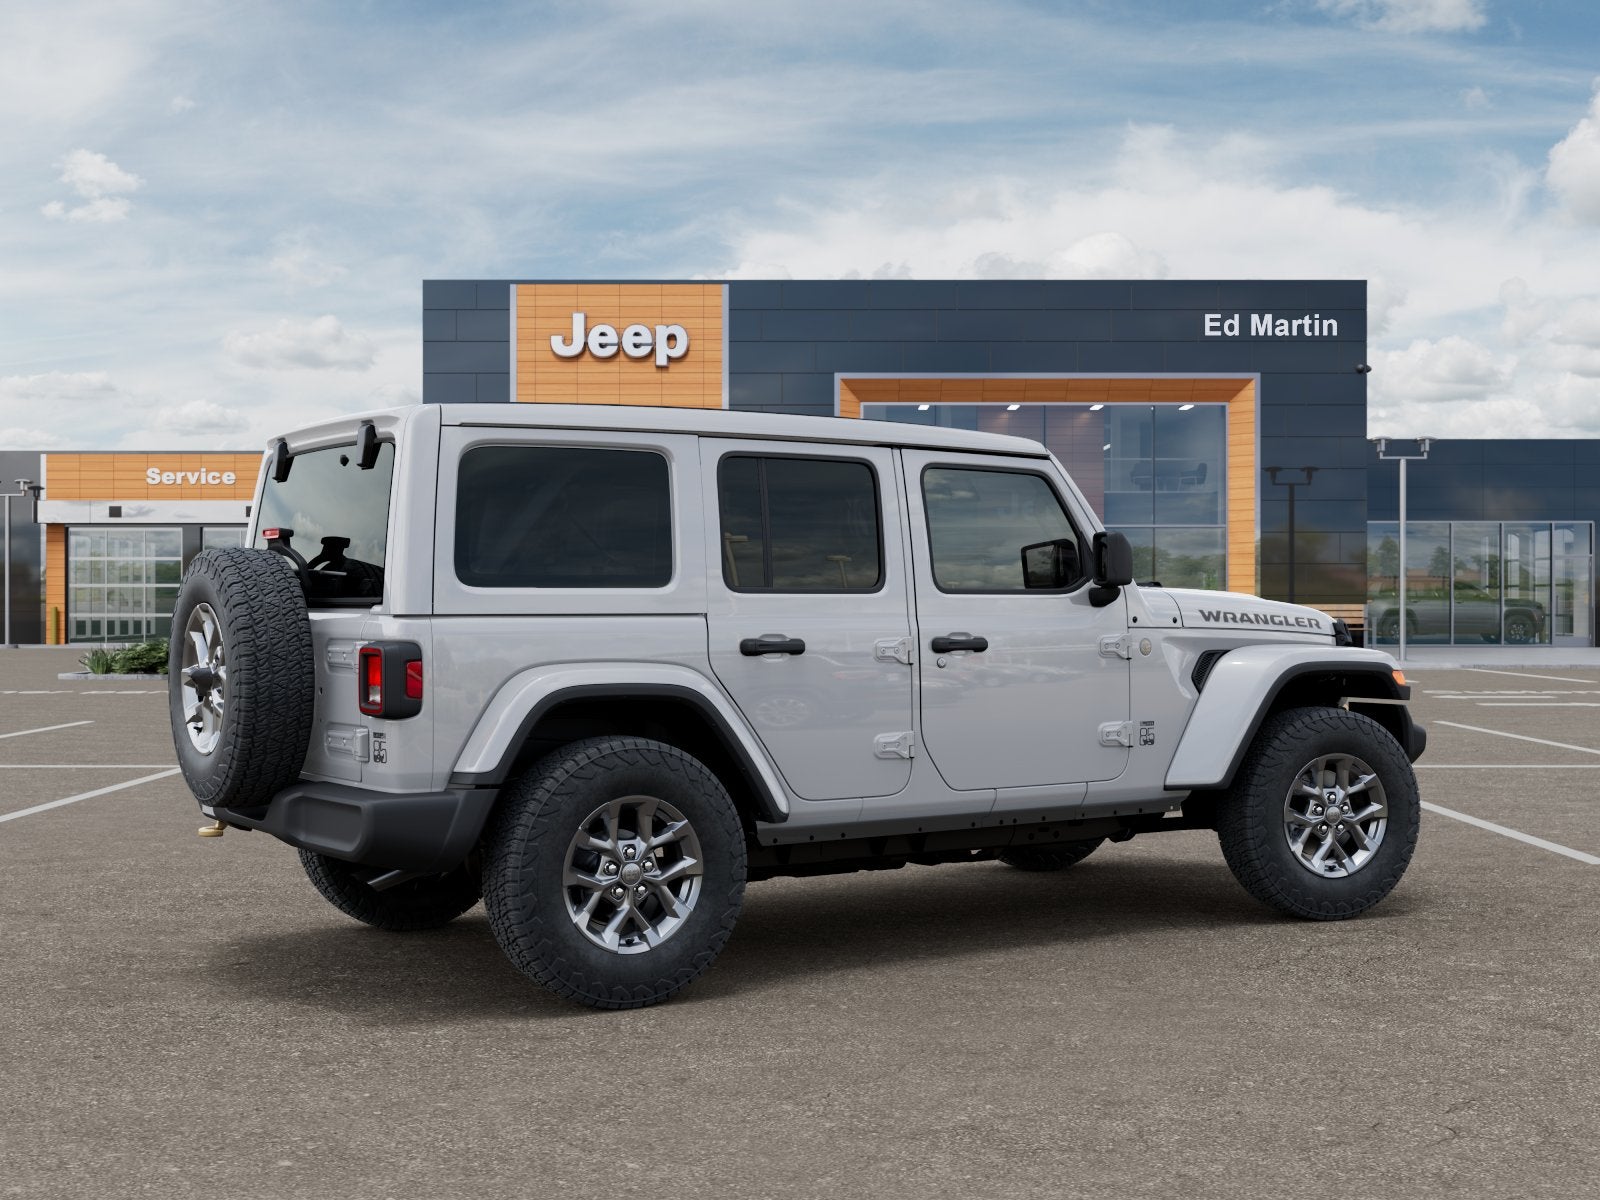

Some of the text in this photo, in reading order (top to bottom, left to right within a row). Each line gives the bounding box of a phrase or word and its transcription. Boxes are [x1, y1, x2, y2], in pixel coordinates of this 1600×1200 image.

[1204, 313, 1338, 337] Ed Martin
[550, 312, 689, 368] Jeep
[146, 467, 236, 485] Service
[1198, 609, 1321, 629] WRANGLER
